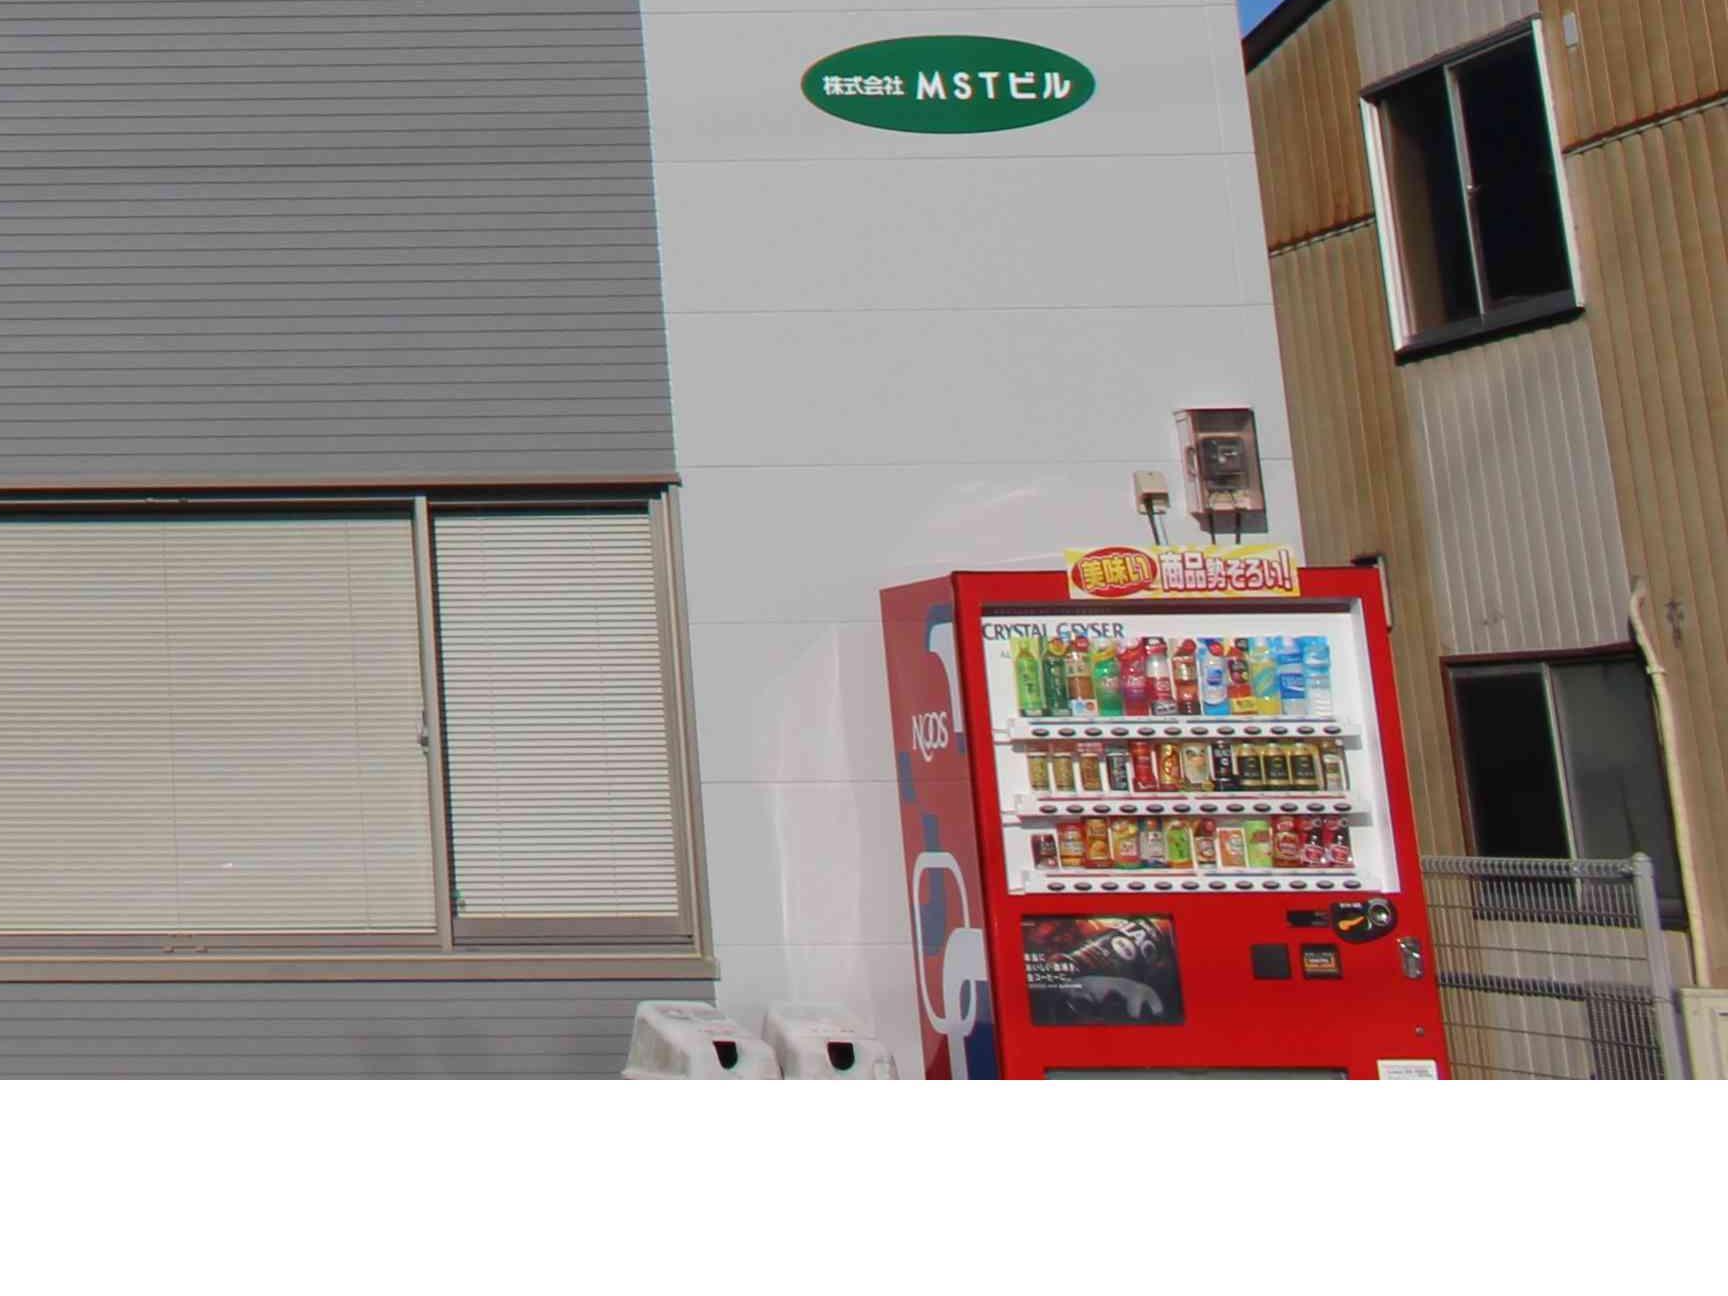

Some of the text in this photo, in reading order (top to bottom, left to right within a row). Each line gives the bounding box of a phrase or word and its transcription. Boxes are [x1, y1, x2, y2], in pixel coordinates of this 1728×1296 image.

[823, 70, 1071, 101] 株式会社 MSTビル
[1081, 555, 1151, 591] 美味い
